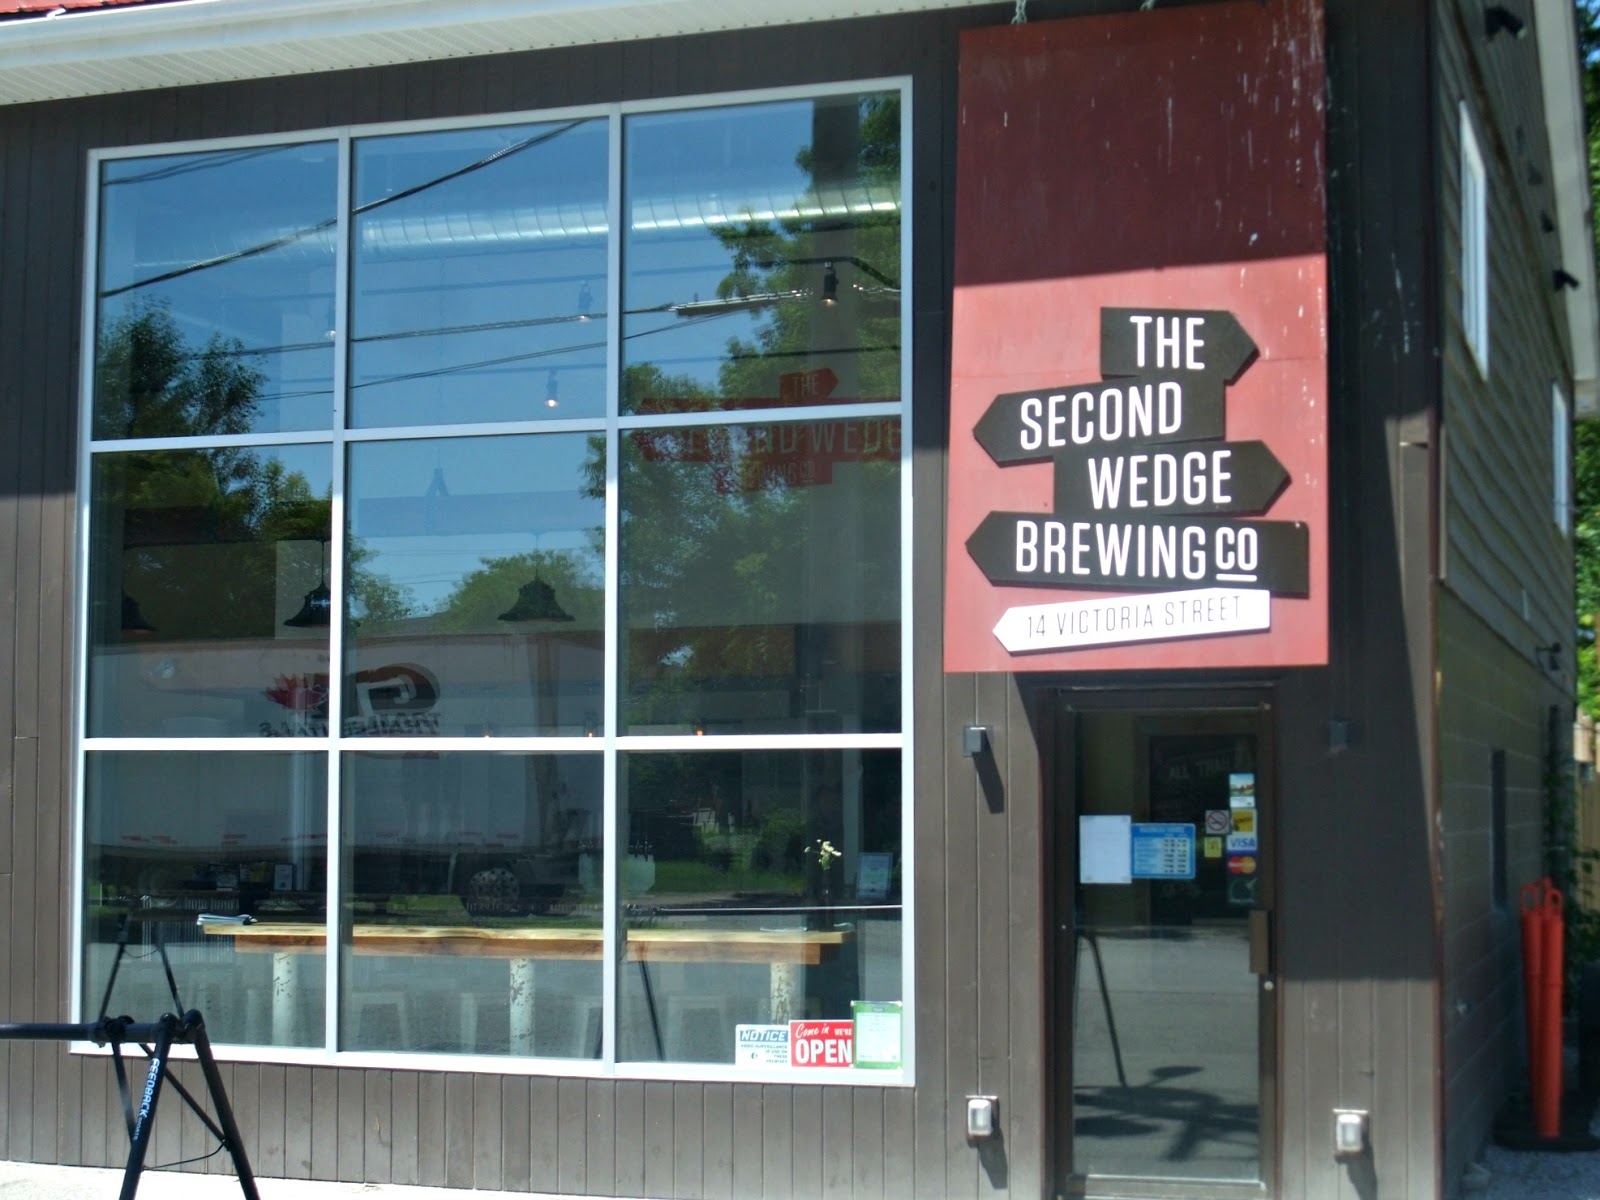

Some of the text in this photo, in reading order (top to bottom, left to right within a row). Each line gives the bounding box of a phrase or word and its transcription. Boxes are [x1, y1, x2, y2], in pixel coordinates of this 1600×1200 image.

[1130, 316, 1205, 370] THE
[1020, 381, 1182, 450] SECOND
[1088, 450, 1232, 510] WEDGE
[1016, 520, 1258, 580] BREWING CO
[1027, 595, 1242, 639] 14 VICTORIA STREET
[1230, 837, 1256, 847] VISA
[740, 1030, 787, 1042] NOTICE
[795, 1023, 819, 1038] Come
[821, 1023, 830, 1035] in
[795, 1038, 853, 1064] OPEN
[139, 1058, 160, 1118] FEEDBACK
